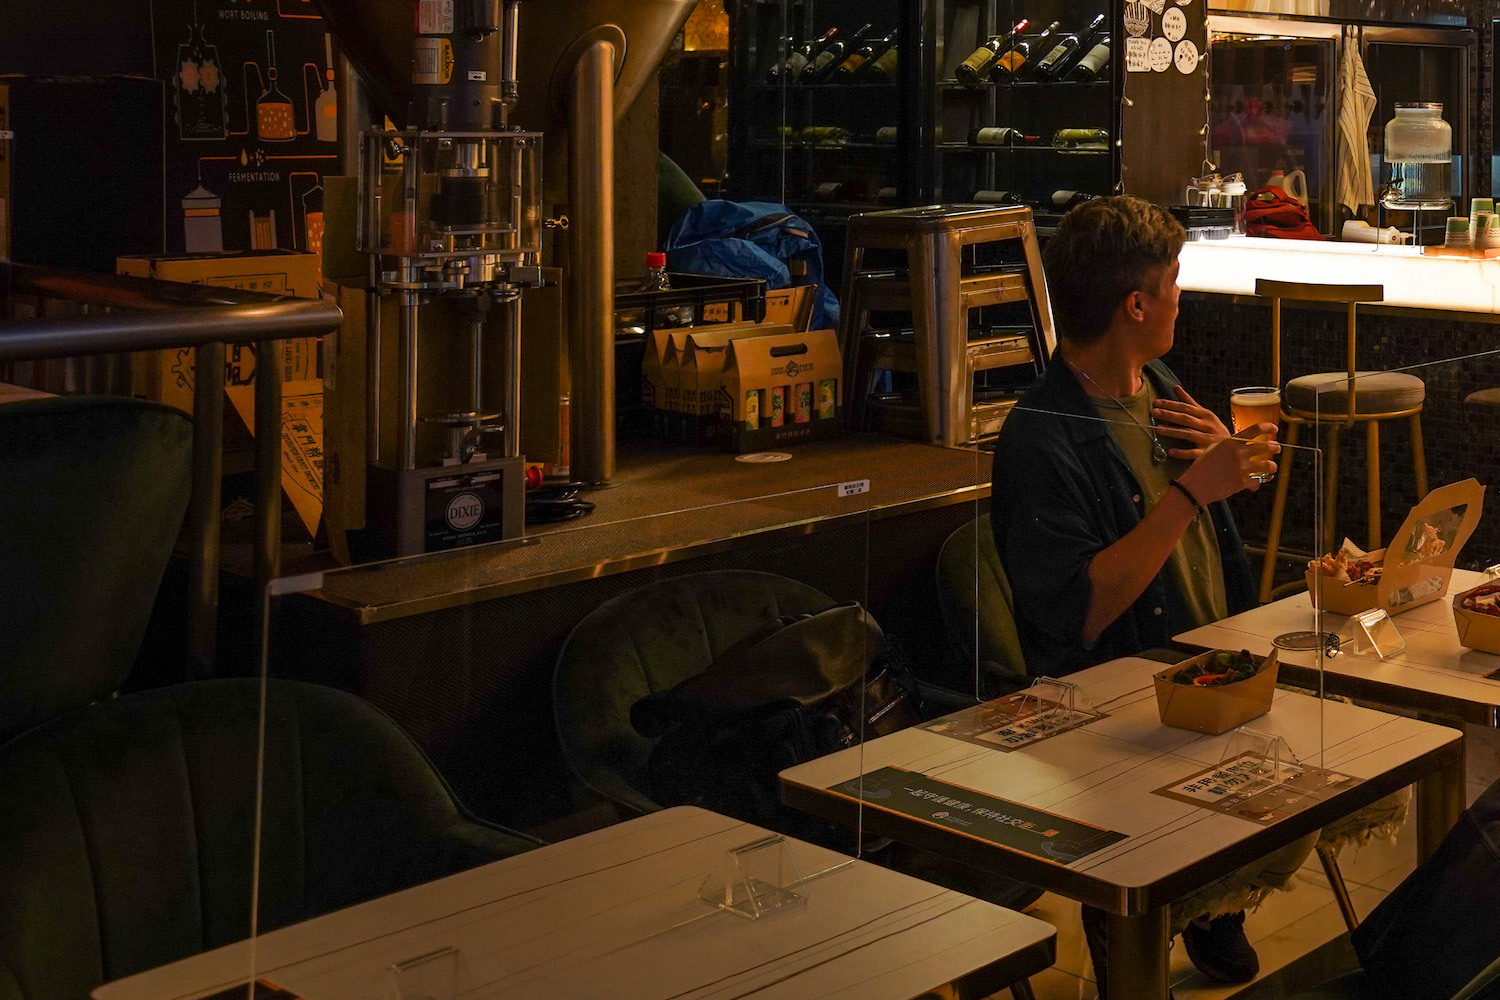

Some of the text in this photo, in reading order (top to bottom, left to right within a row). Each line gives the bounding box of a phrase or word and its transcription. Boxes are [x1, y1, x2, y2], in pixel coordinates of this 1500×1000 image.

[218, 9, 269, 22] WORT BOILING
[229, 172, 280, 183] FERMENTATION
[450, 504, 480, 519] DIXIE
